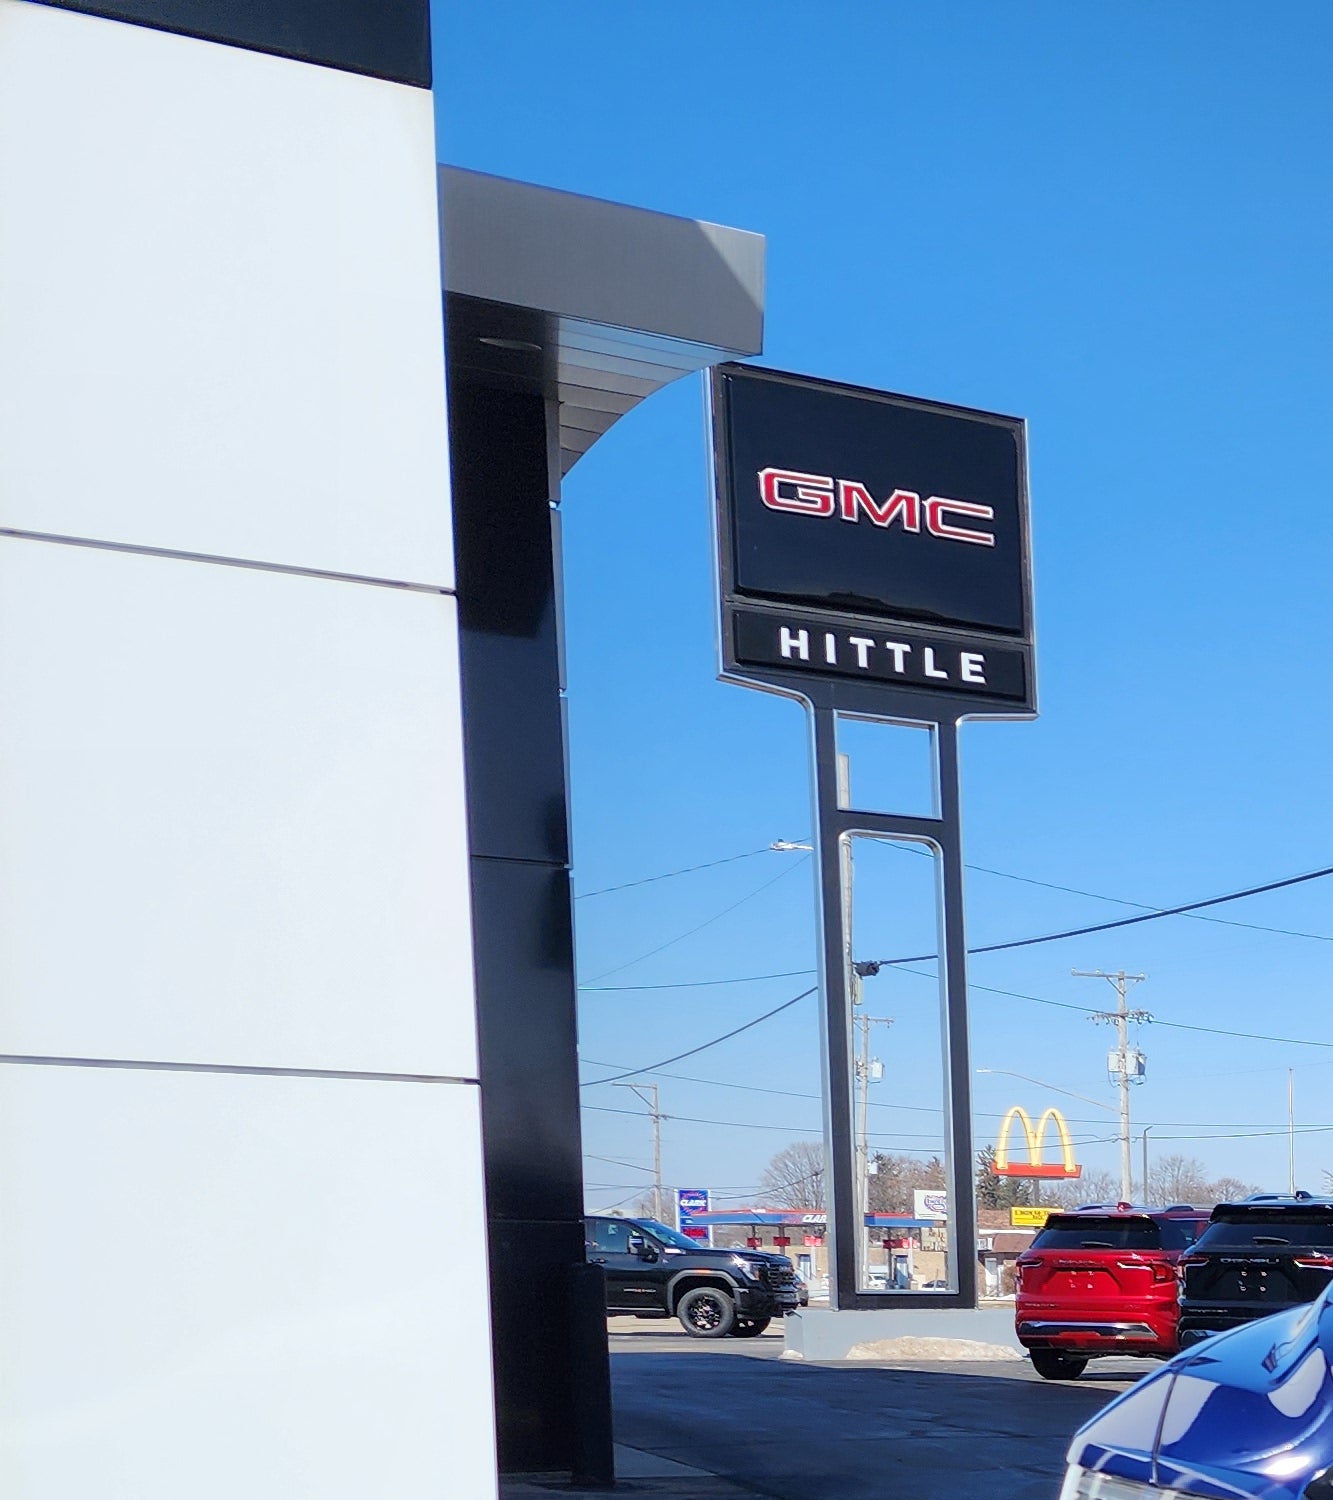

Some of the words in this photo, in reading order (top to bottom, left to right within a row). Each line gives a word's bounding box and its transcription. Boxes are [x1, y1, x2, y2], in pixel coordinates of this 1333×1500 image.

[757, 467, 995, 547] GMC
[779, 627, 987, 685] HITTLE
[680, 1199, 707, 1207] CLARK
[802, 1214, 828, 1224] CLAR
